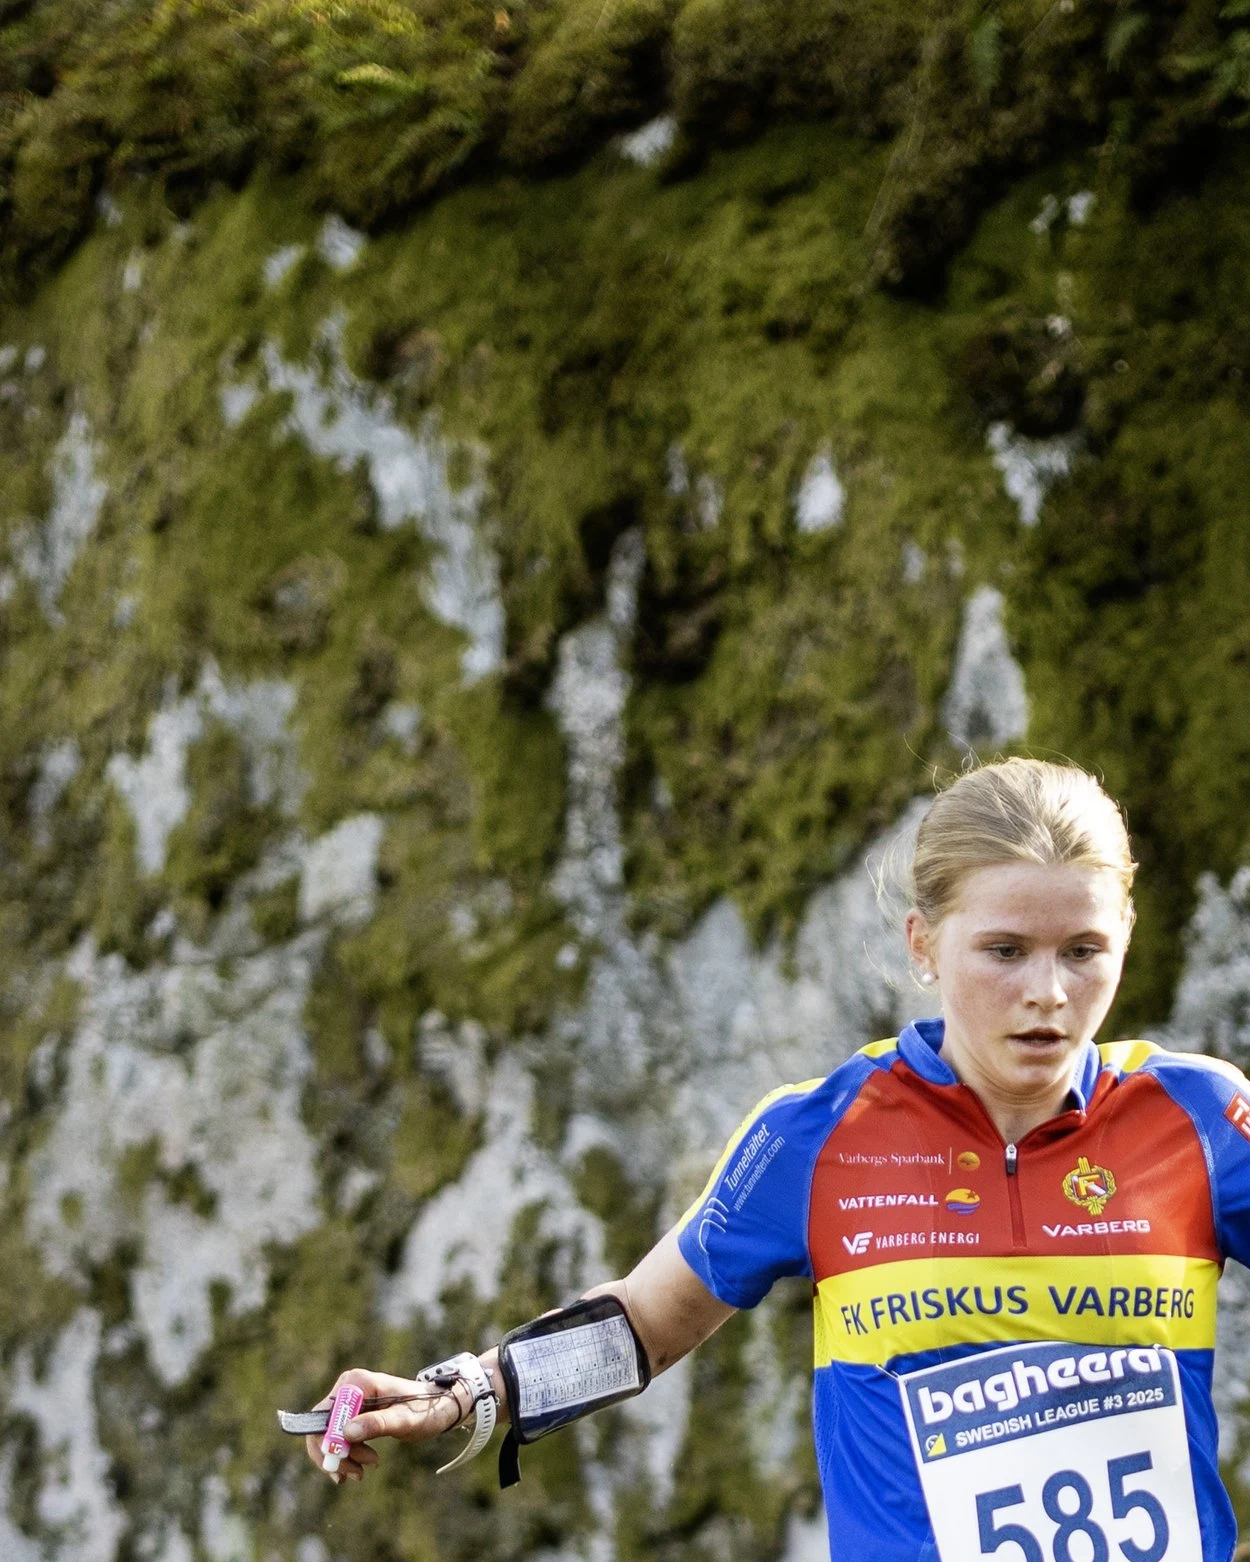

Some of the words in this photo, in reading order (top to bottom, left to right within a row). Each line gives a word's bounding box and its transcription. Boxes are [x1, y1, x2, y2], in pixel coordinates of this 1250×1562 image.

[723, 1122, 771, 1192] Tunneltältet
[839, 1152, 888, 1167] Varbergs
[890, 1152, 945, 1167] Sparbank
[838, 1194, 939, 1211] VATTENFALL
[875, 1232, 926, 1249] VARBERG
[930, 1231, 980, 1245] ENERGI
[1042, 1219, 1151, 1238] VARBERG
[840, 1302, 869, 1336] FK
[870, 1285, 1029, 1330] FRISKUS
[1049, 1285, 1195, 1319] VARBERG
[917, 1348, 1162, 1425] bagheera
[955, 1414, 1033, 1449] SWEDISH
[1035, 1398, 1100, 1427] LEAGUE
[1102, 1395, 1124, 1411] #3
[1126, 1387, 1165, 1406] 2025
